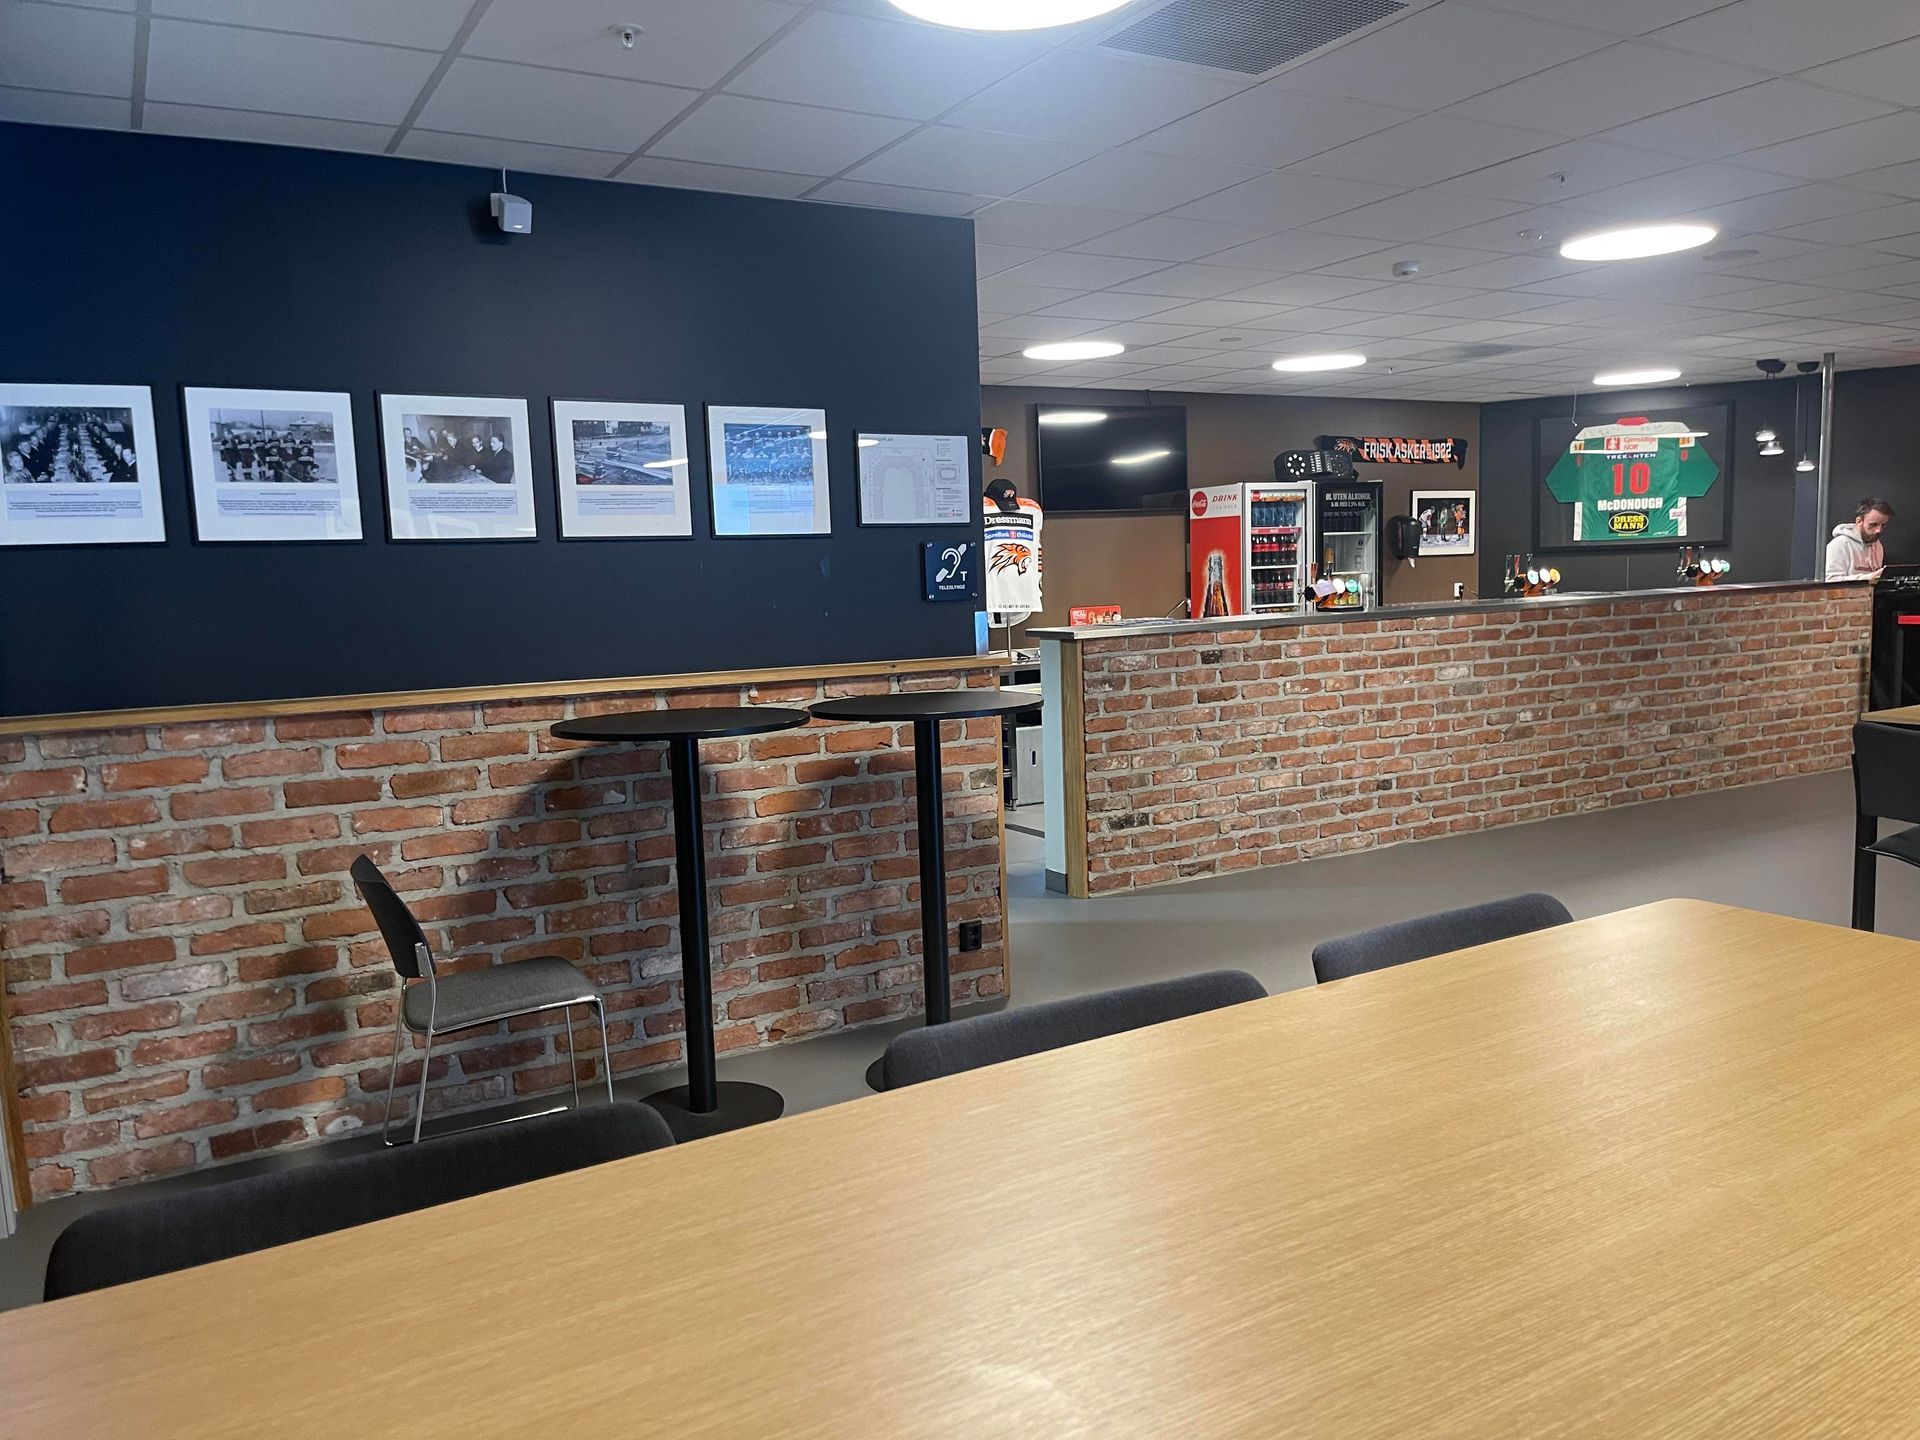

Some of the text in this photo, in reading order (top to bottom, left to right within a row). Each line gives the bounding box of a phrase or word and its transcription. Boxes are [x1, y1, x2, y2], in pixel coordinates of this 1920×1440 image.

[1364, 442, 1393, 459] FRISK
[1395, 443, 1426, 459] ASKER
[1431, 442, 1452, 460] 1922
[1612, 462, 1650, 495] 10
[1212, 494, 1238, 503] DRINK
[1597, 497, 1663, 511] McDONOUGH
[984, 516, 1032, 526] Dressmann
[960, 571, 967, 582] T
